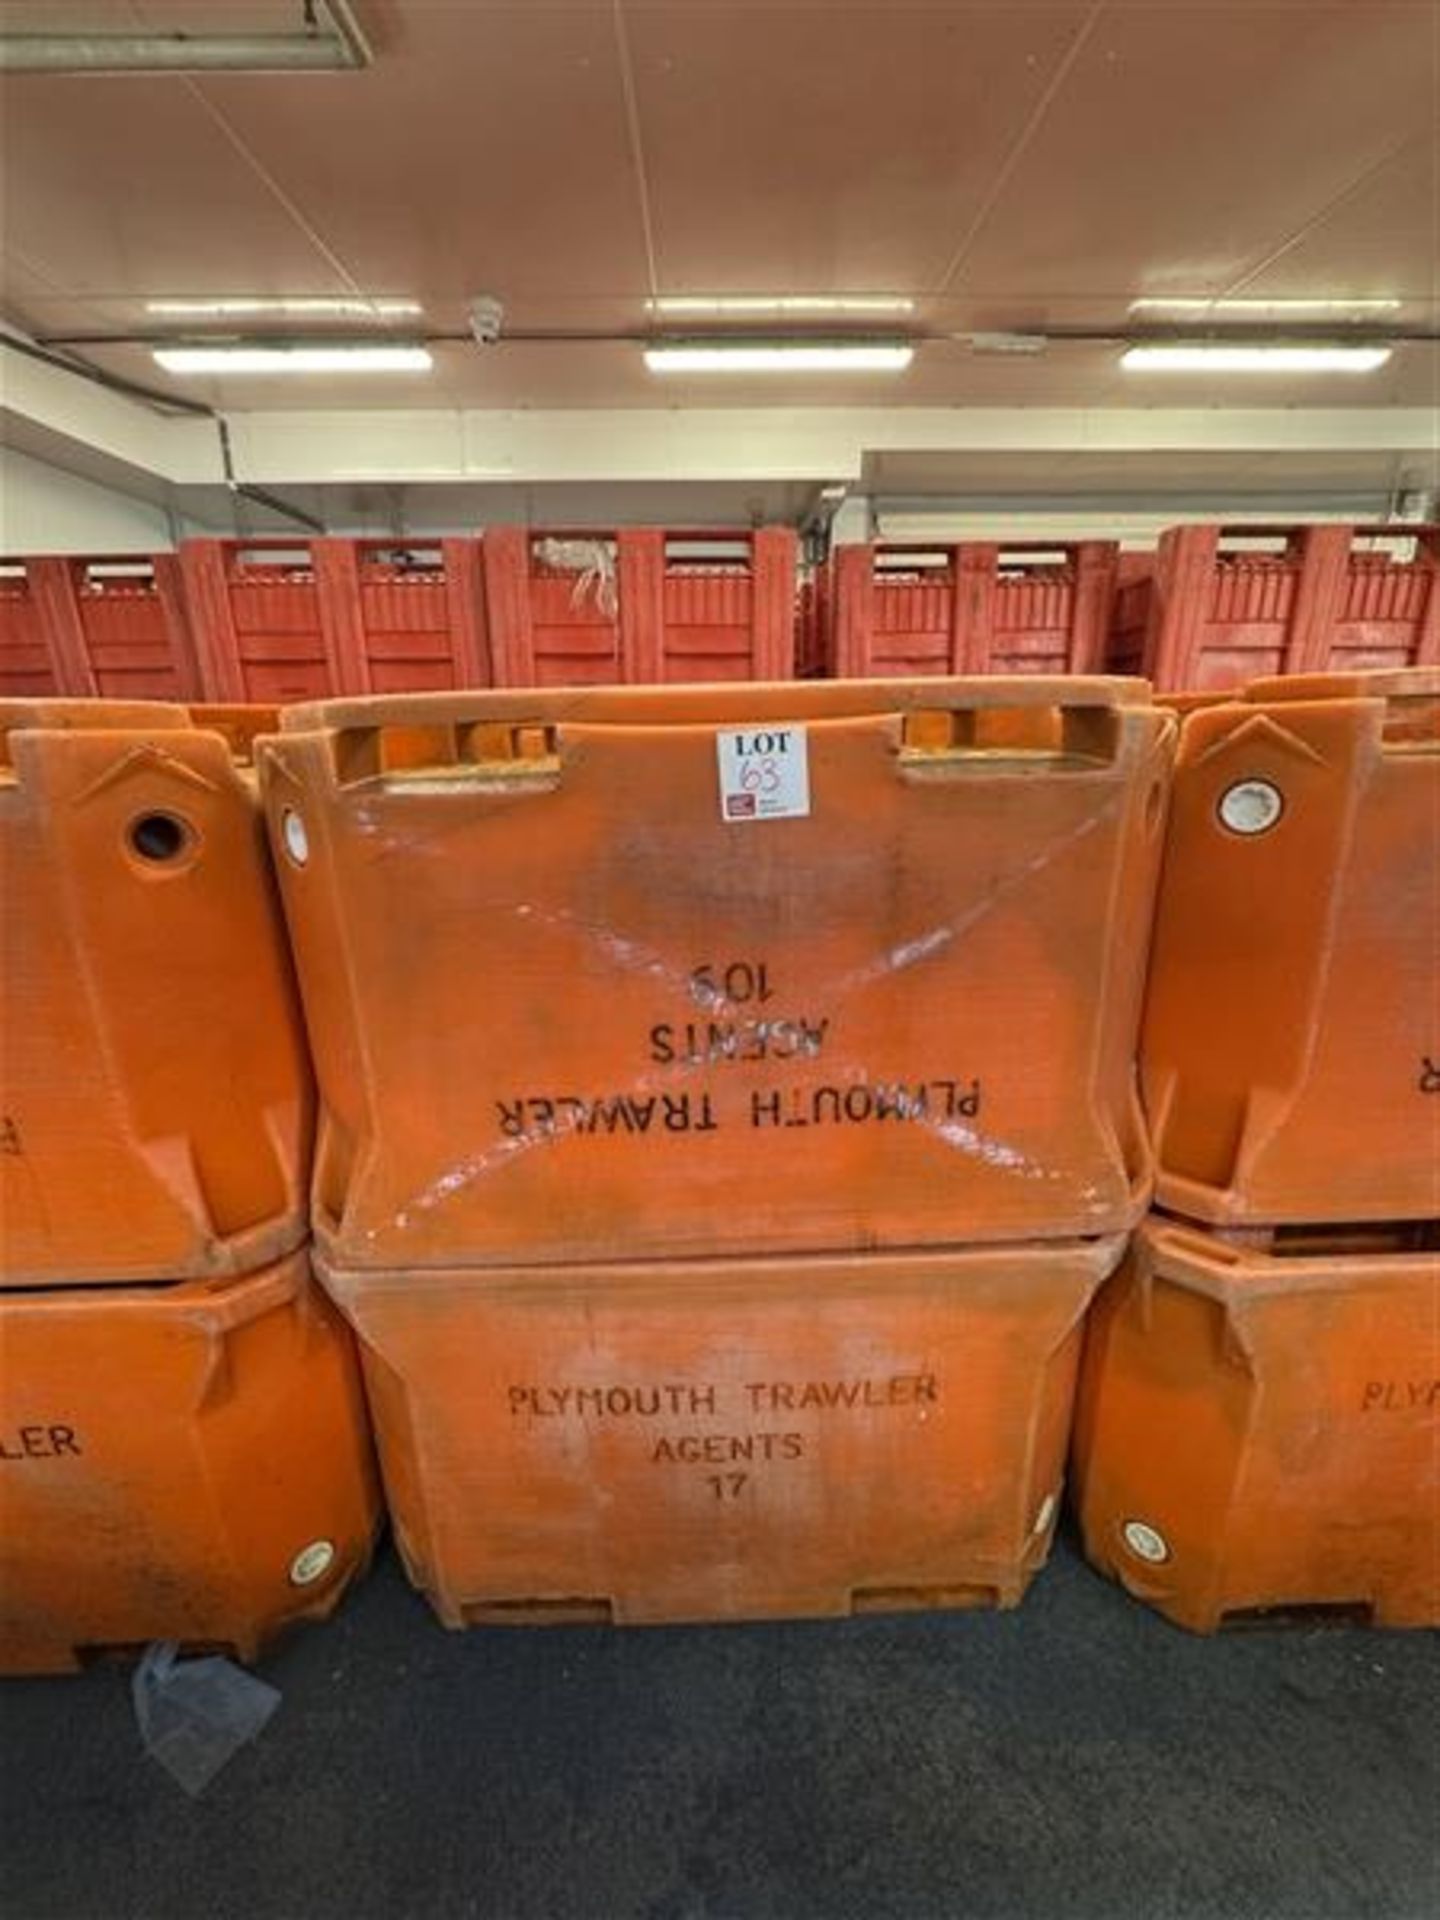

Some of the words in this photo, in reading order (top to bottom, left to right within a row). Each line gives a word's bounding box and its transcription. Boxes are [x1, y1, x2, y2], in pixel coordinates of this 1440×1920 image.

[736, 731, 790, 755] LOT
[740, 759, 780, 792] 63
[649, 1018, 829, 1064] AGENTS
[496, 1093, 718, 1137] TRAWLER
[752, 1079, 980, 1128] PLYMOUTH
[507, 1384, 716, 1417] PLYMOUTH
[744, 1373, 938, 1412] TRAWLER
[651, 1432, 803, 1463] AGENTS
[708, 1472, 748, 1500] 17
